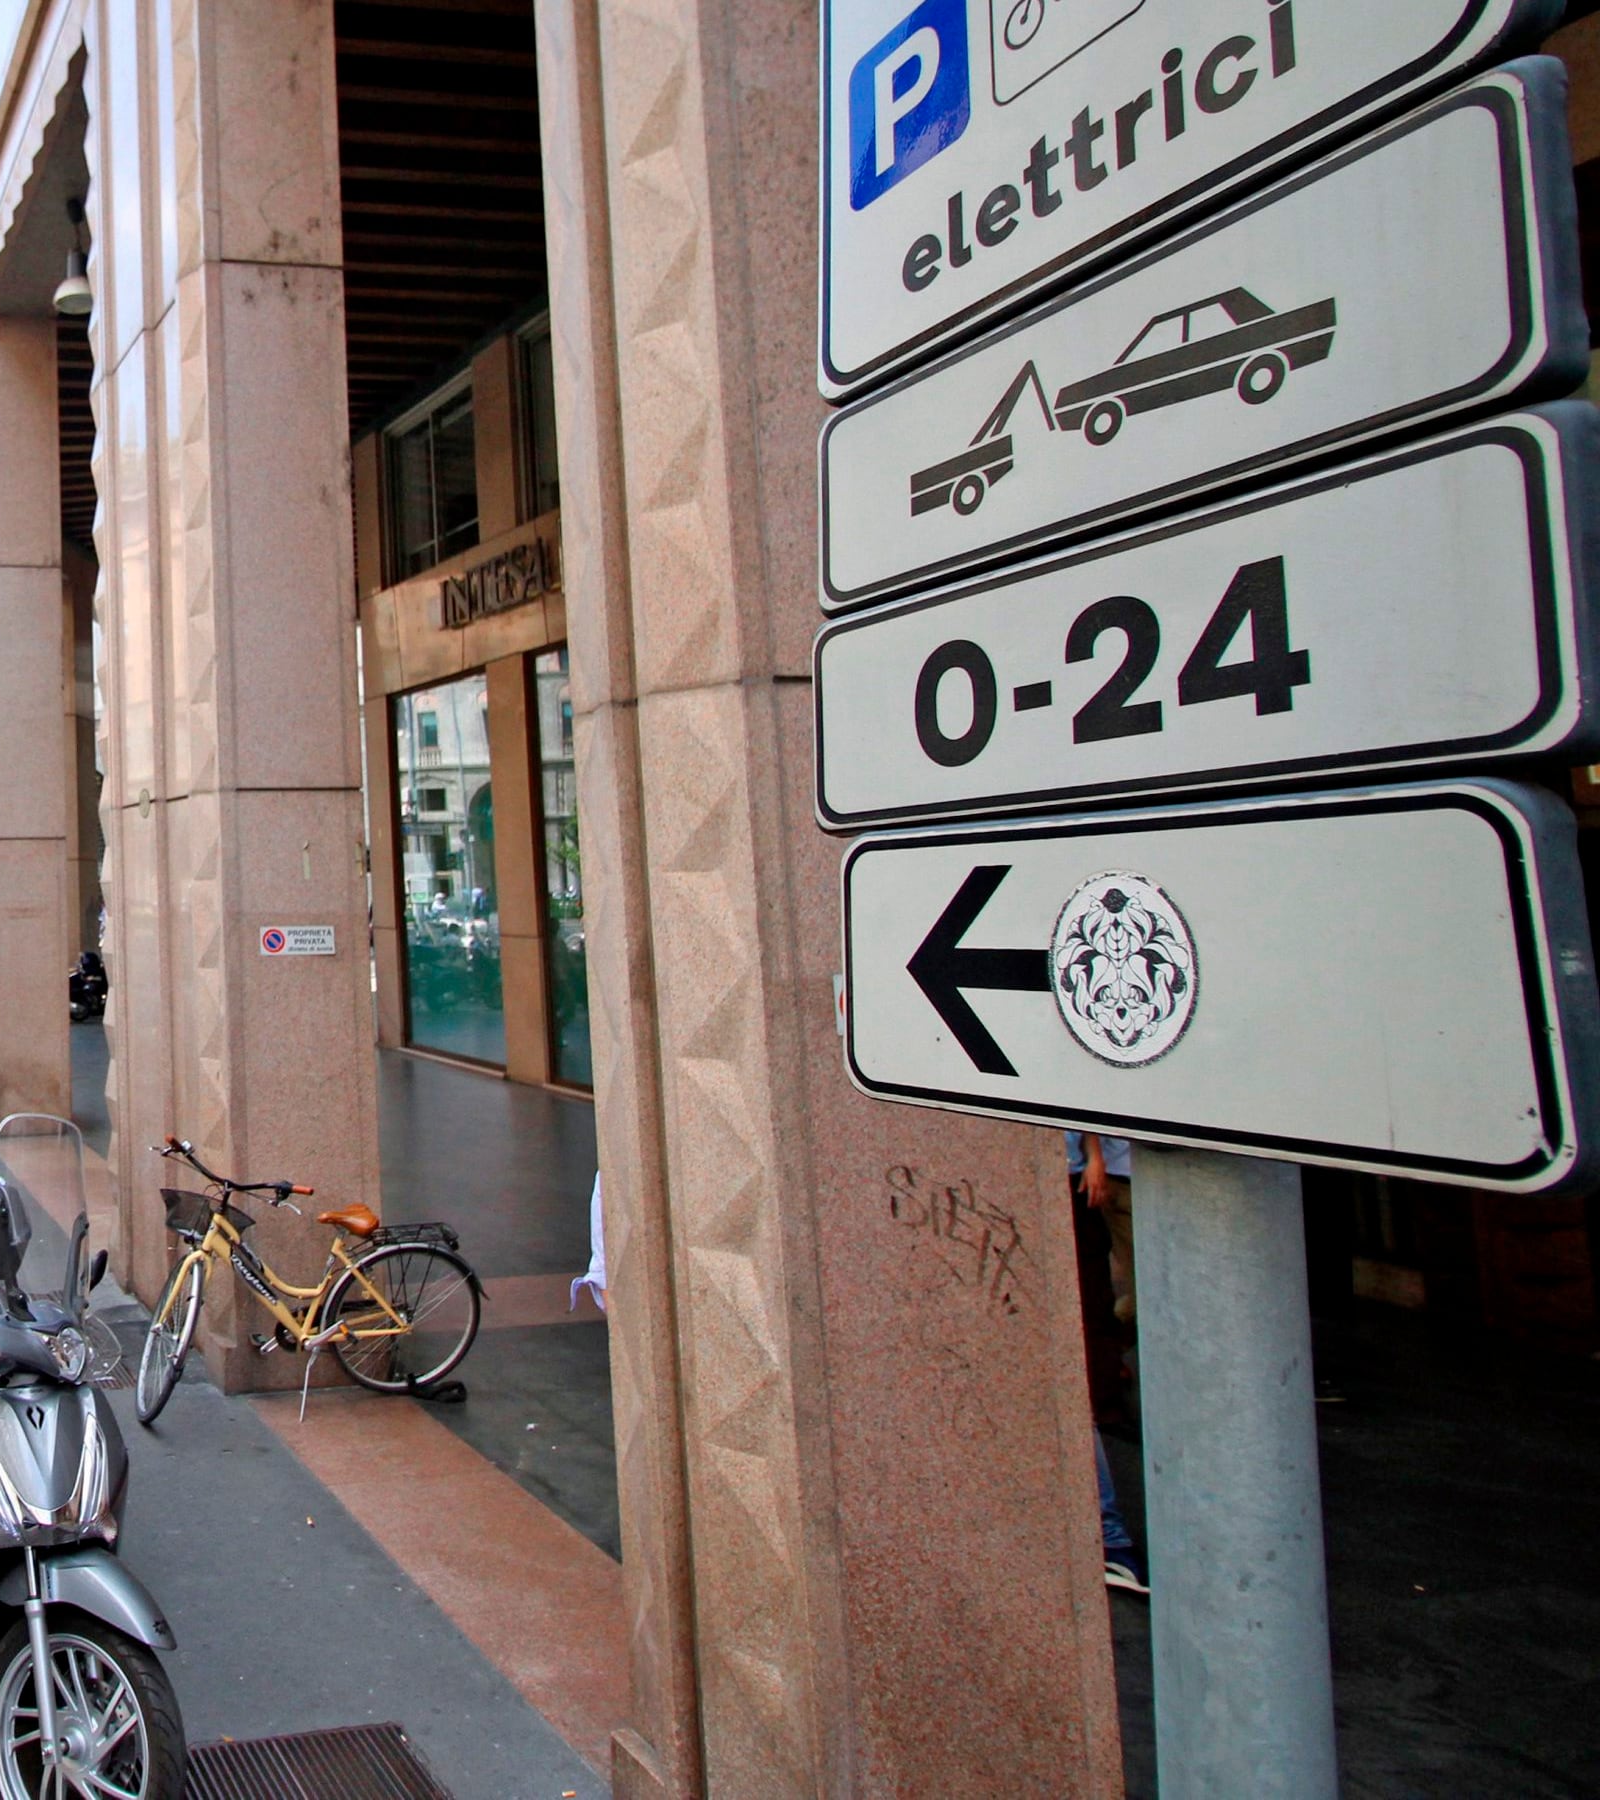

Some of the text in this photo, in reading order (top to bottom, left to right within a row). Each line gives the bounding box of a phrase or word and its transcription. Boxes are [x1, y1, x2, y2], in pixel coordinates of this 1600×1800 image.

[874, 25, 941, 179] P
[902, 0, 1297, 293] elettrici
[439, 535, 552, 631] INTESA
[914, 554, 1312, 768] 0-24
[287, 928, 333, 937] PROPRIETÀ
